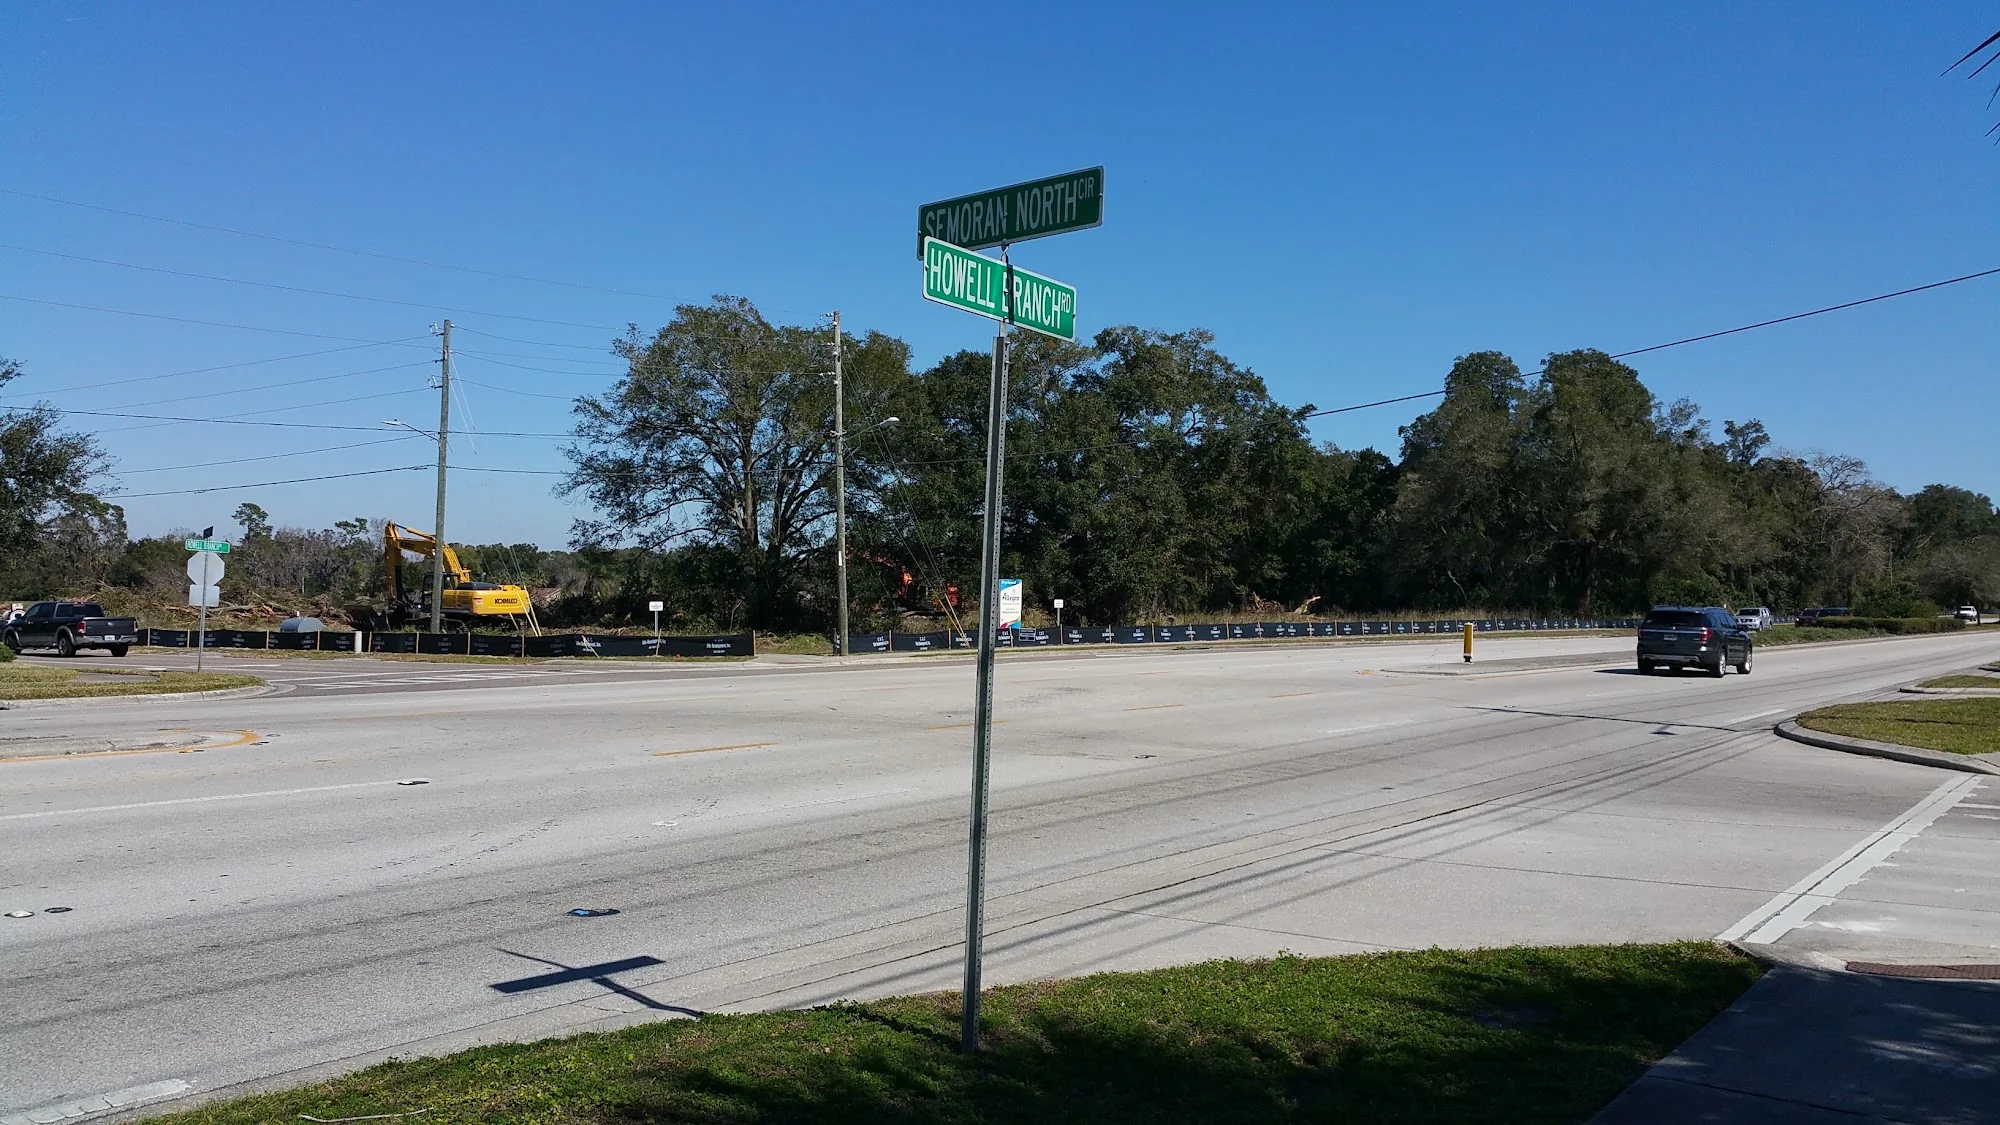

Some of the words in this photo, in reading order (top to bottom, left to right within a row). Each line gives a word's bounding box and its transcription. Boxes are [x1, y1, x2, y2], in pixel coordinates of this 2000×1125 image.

[925, 194, 1008, 244] SEMORAN
[1016, 179, 1078, 232] NORTH
[1078, 176, 1095, 200] CIR
[930, 248, 996, 309] HOWELL
[1002, 271, 1062, 329] BRANCH
[1062, 292, 1071, 314] RD
